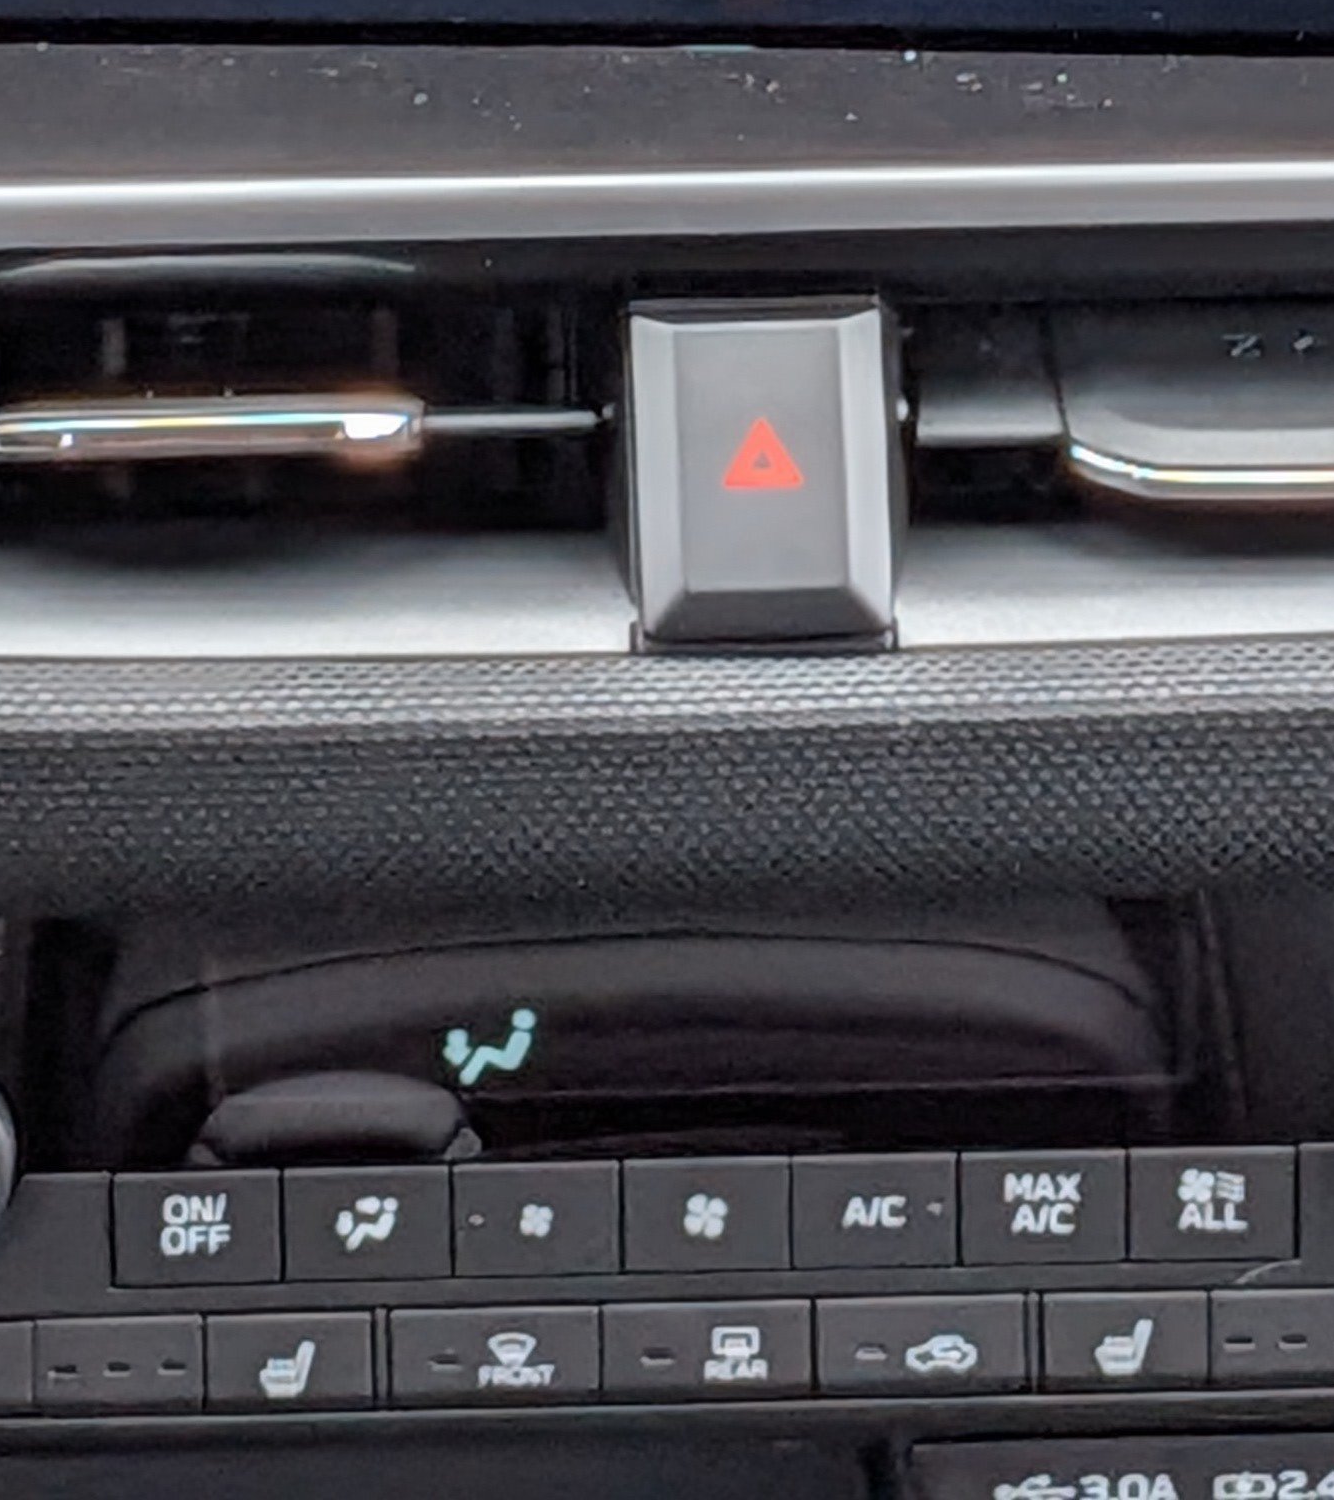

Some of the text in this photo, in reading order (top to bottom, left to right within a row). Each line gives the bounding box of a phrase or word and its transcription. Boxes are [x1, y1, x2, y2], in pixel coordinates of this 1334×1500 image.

[1003, 1172, 1082, 1203] MAX
[162, 1192, 228, 1225] ON/
[841, 1194, 907, 1229] A/C
[1010, 1204, 1077, 1235] A/C
[1177, 1203, 1249, 1233] ALL
[159, 1224, 232, 1257] OFF
[477, 1362, 556, 1388] FRONT
[703, 1357, 769, 1382] REAR
[1078, 1472, 1181, 1500] 3.0A
